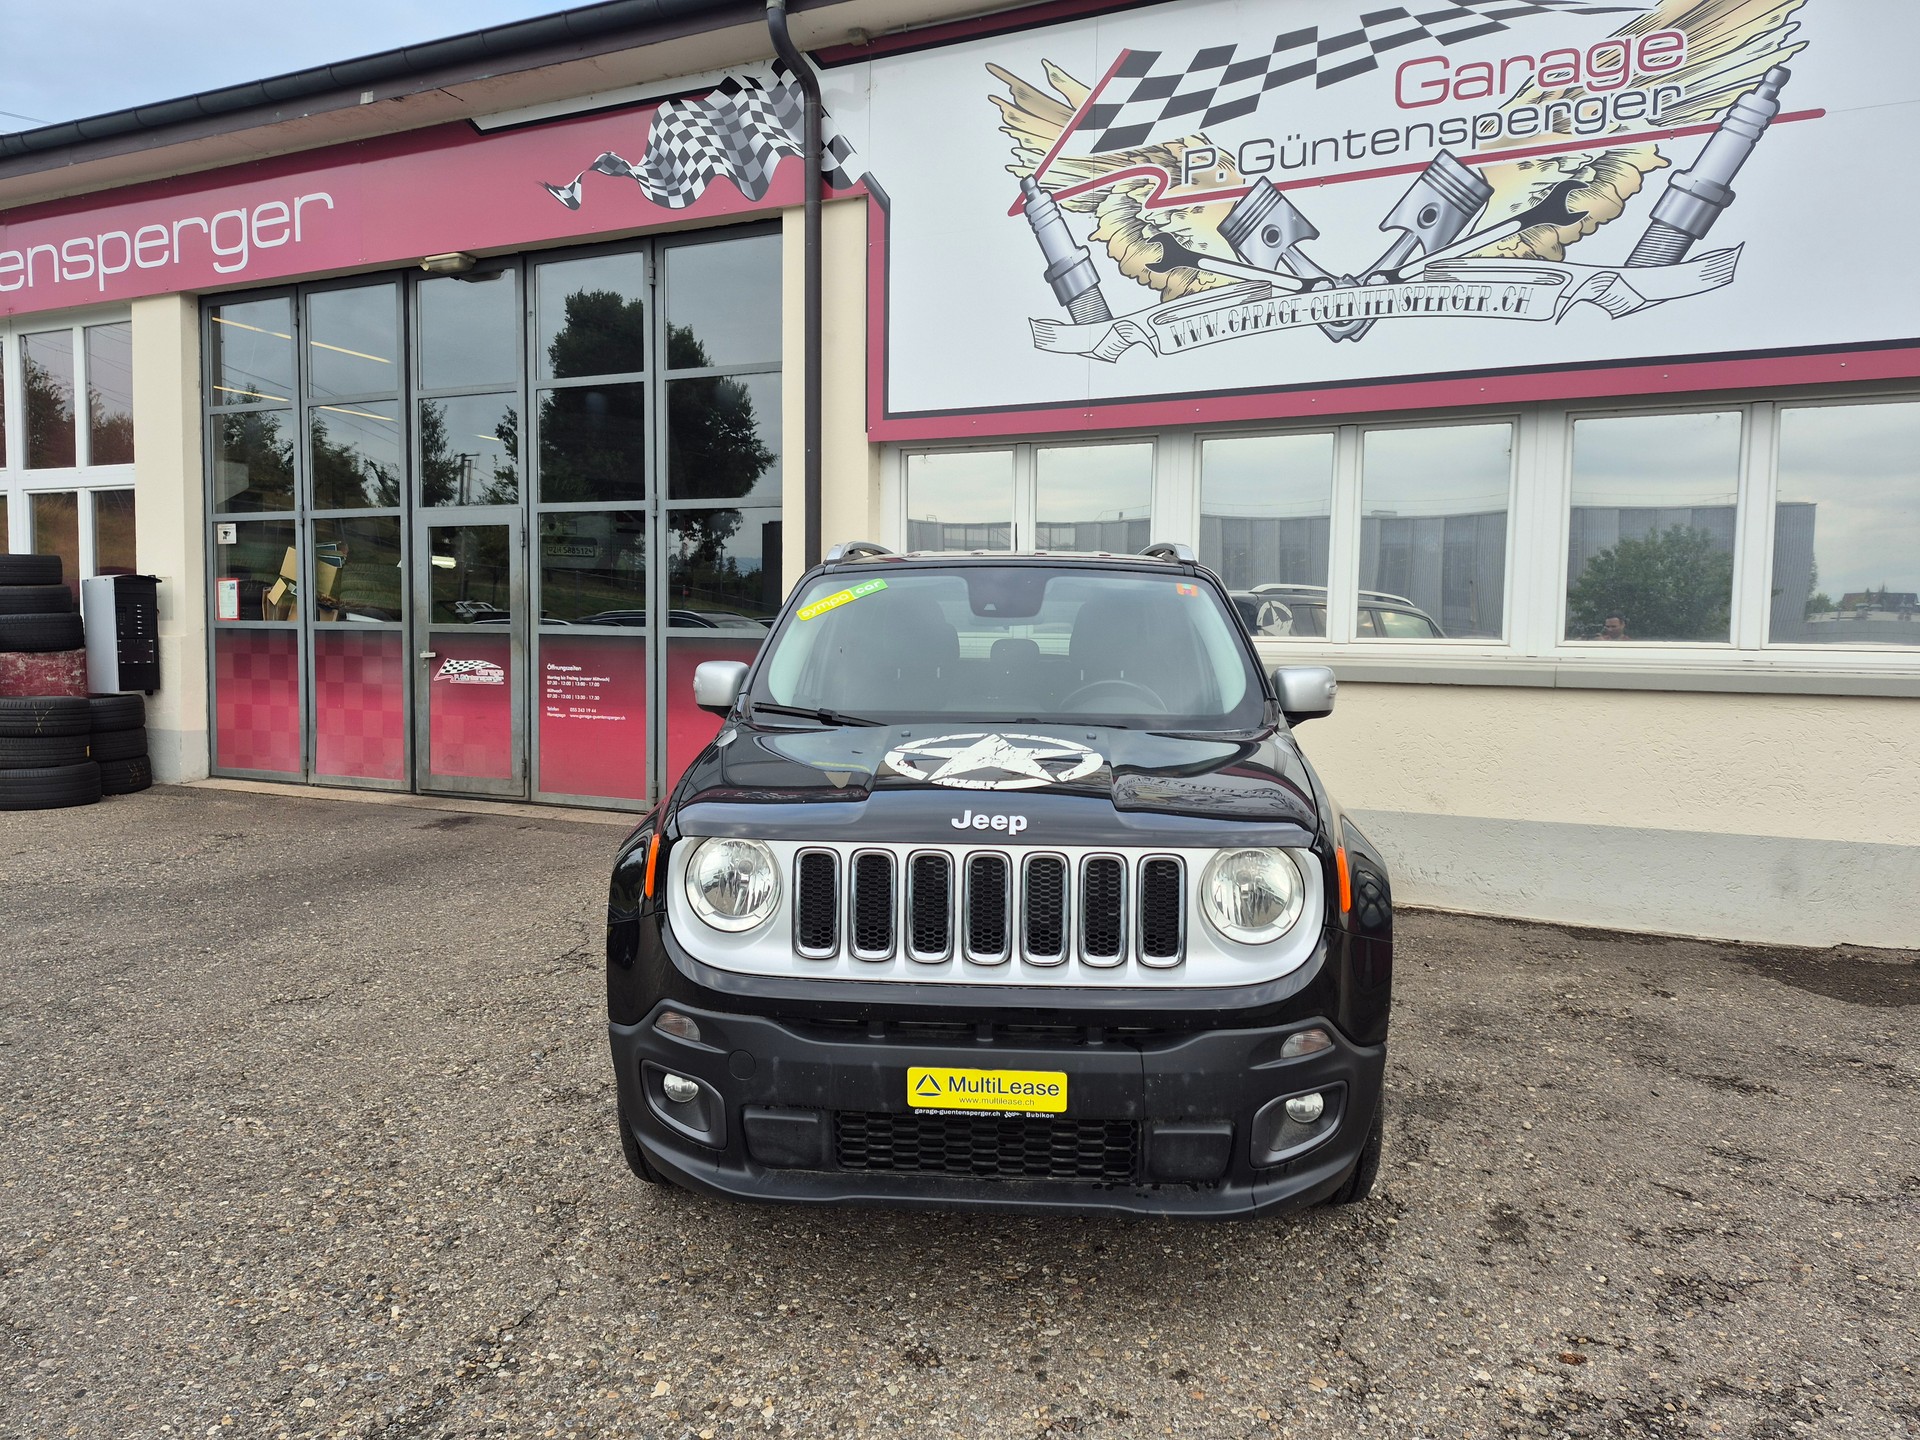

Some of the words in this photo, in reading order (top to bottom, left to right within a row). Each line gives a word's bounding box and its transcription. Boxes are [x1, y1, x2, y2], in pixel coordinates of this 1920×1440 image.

[1394, 31, 1684, 110] Garage
[1184, 147, 1224, 185] P.
[1237, 85, 1683, 175] Güntensperger
[1169, 285, 1535, 348] WWW.GARAGE-GUENTENSPERGER.CH
[855, 580, 881, 594] car
[547, 663, 581, 672] Öffnungszeiten
[951, 810, 1028, 835] Jeep
[948, 1076, 1060, 1097] MultiLease
[959, 1097, 1035, 1106] www.multilease.ch
[914, 1108, 1001, 1117] garage-guentensperger.ch
